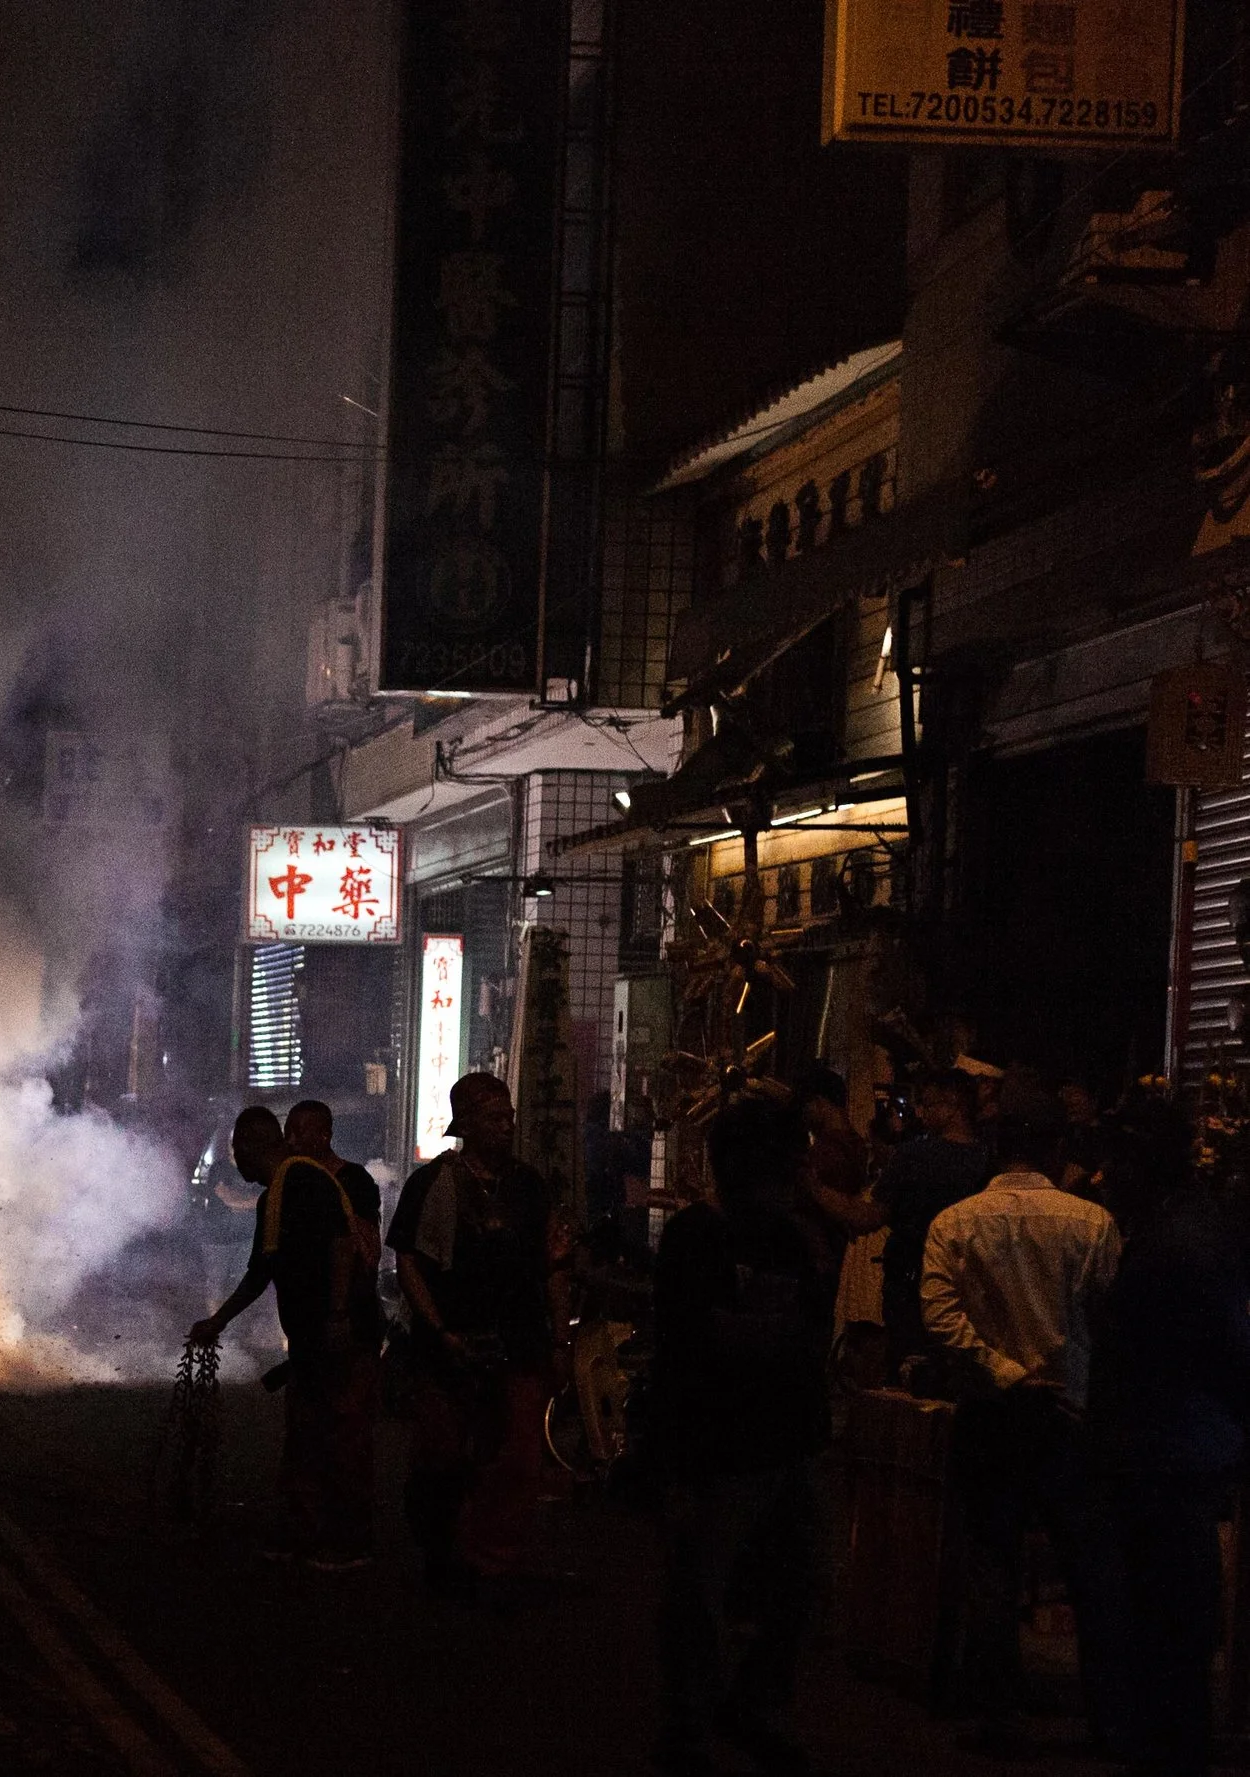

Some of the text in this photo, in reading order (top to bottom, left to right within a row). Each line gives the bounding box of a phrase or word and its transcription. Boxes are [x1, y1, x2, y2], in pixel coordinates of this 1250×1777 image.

[282, 830, 367, 858] 寶和堂
[267, 864, 380, 921] 中藥
[299, 924, 361, 937] 7224876
